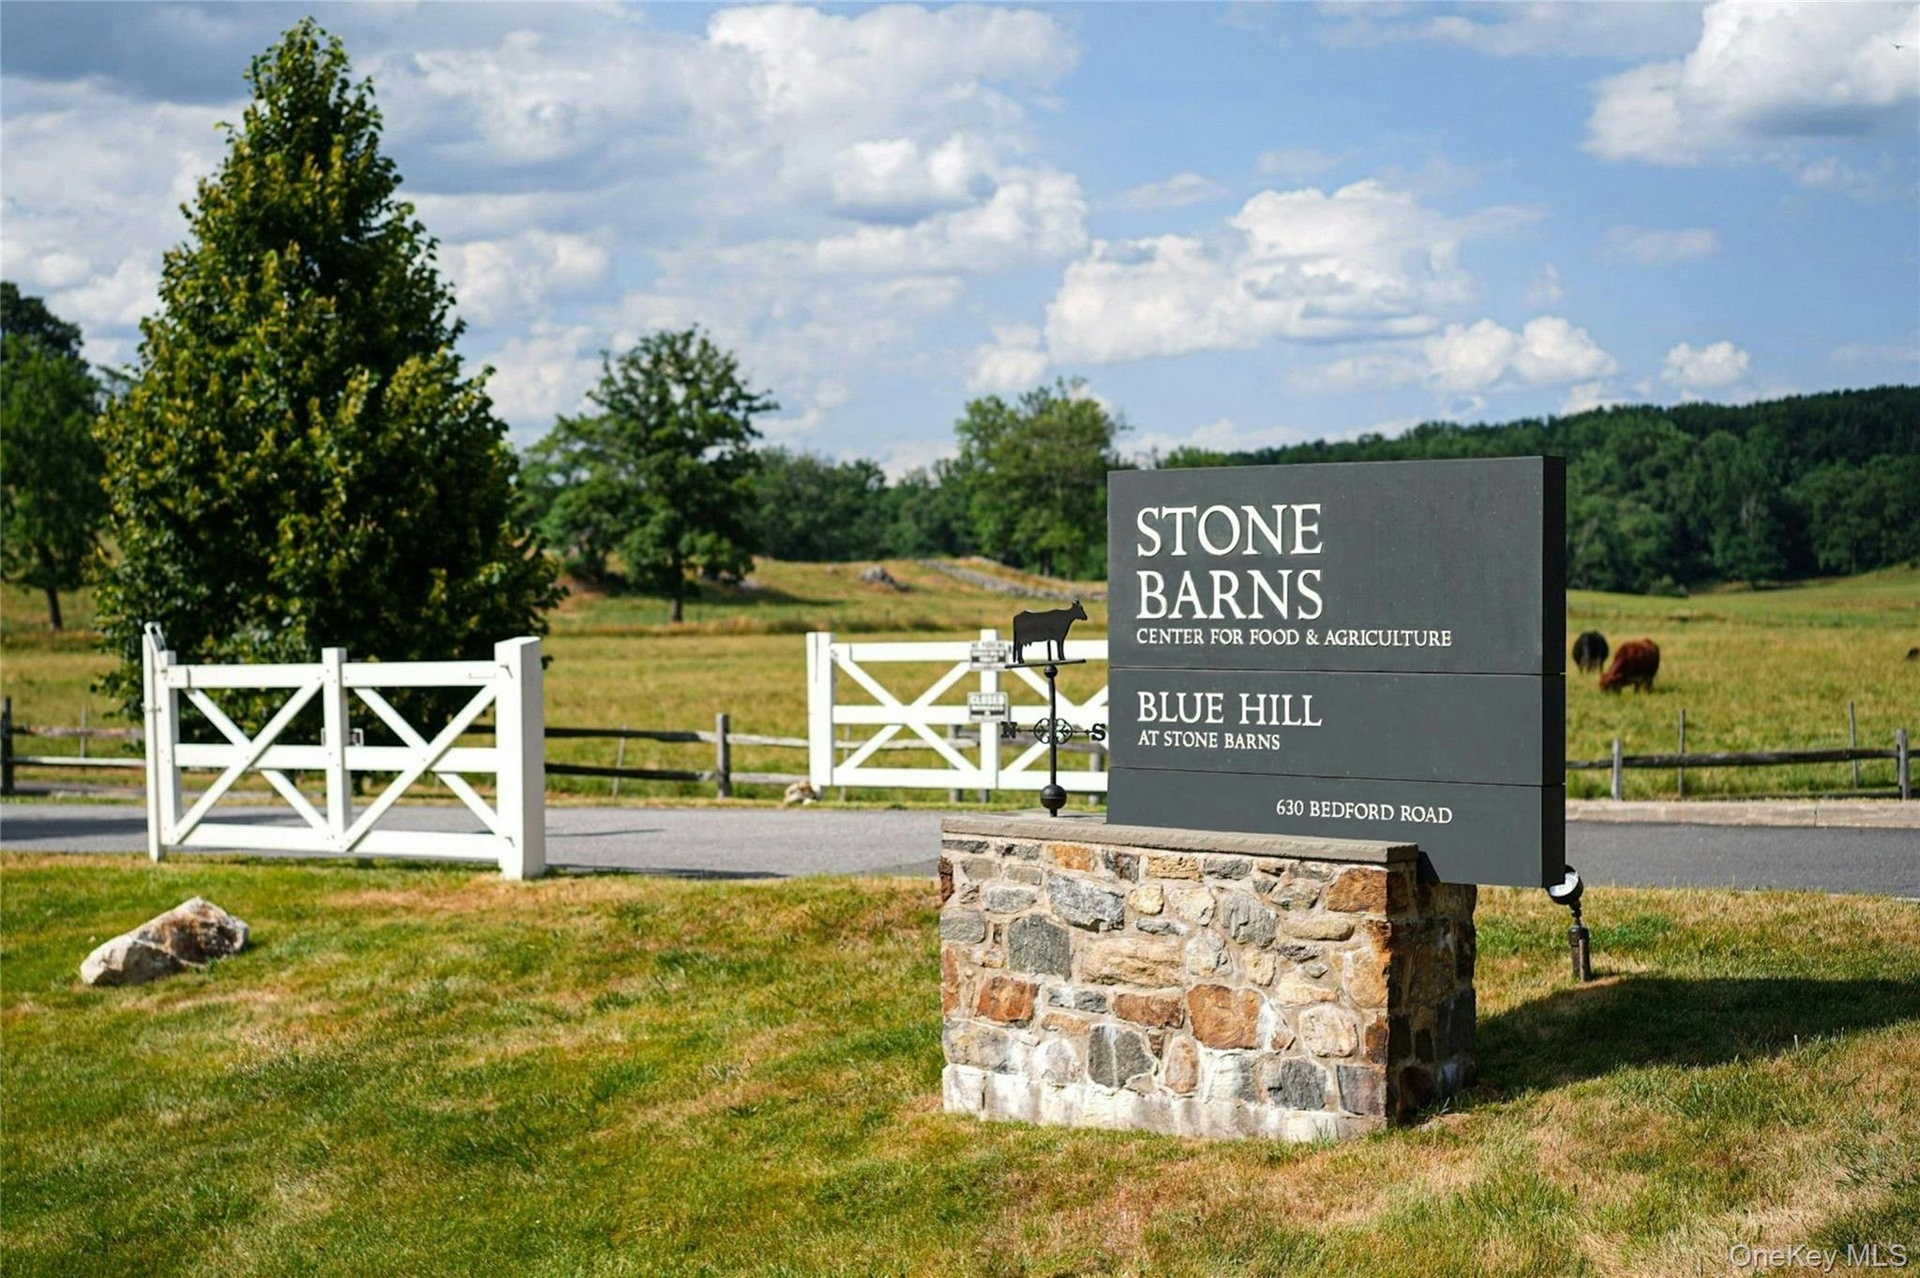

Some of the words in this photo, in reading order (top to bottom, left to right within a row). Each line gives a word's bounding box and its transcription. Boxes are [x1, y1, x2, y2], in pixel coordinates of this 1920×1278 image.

[1136, 503, 1324, 557] STONE
[1136, 569, 1324, 620] BARNS
[1136, 628, 1205, 645] CENTER
[1210, 628, 1245, 645] FOR
[1249, 629, 1300, 645] FOOD
[1305, 629, 1321, 645] &
[1323, 629, 1453, 646] AGRICULTURE
[1136, 691, 1225, 723] BLUE
[1238, 693, 1323, 726] HILL
[1001, 721, 1017, 739] N
[1091, 723, 1106, 741] S
[1137, 730, 1161, 746] AT
[1164, 731, 1219, 748] STONE
[1223, 733, 1281, 750] BARNS
[1275, 799, 1305, 816] 630
[1309, 801, 1395, 820] BEDFORD
[1400, 805, 1453, 823] ROAD
